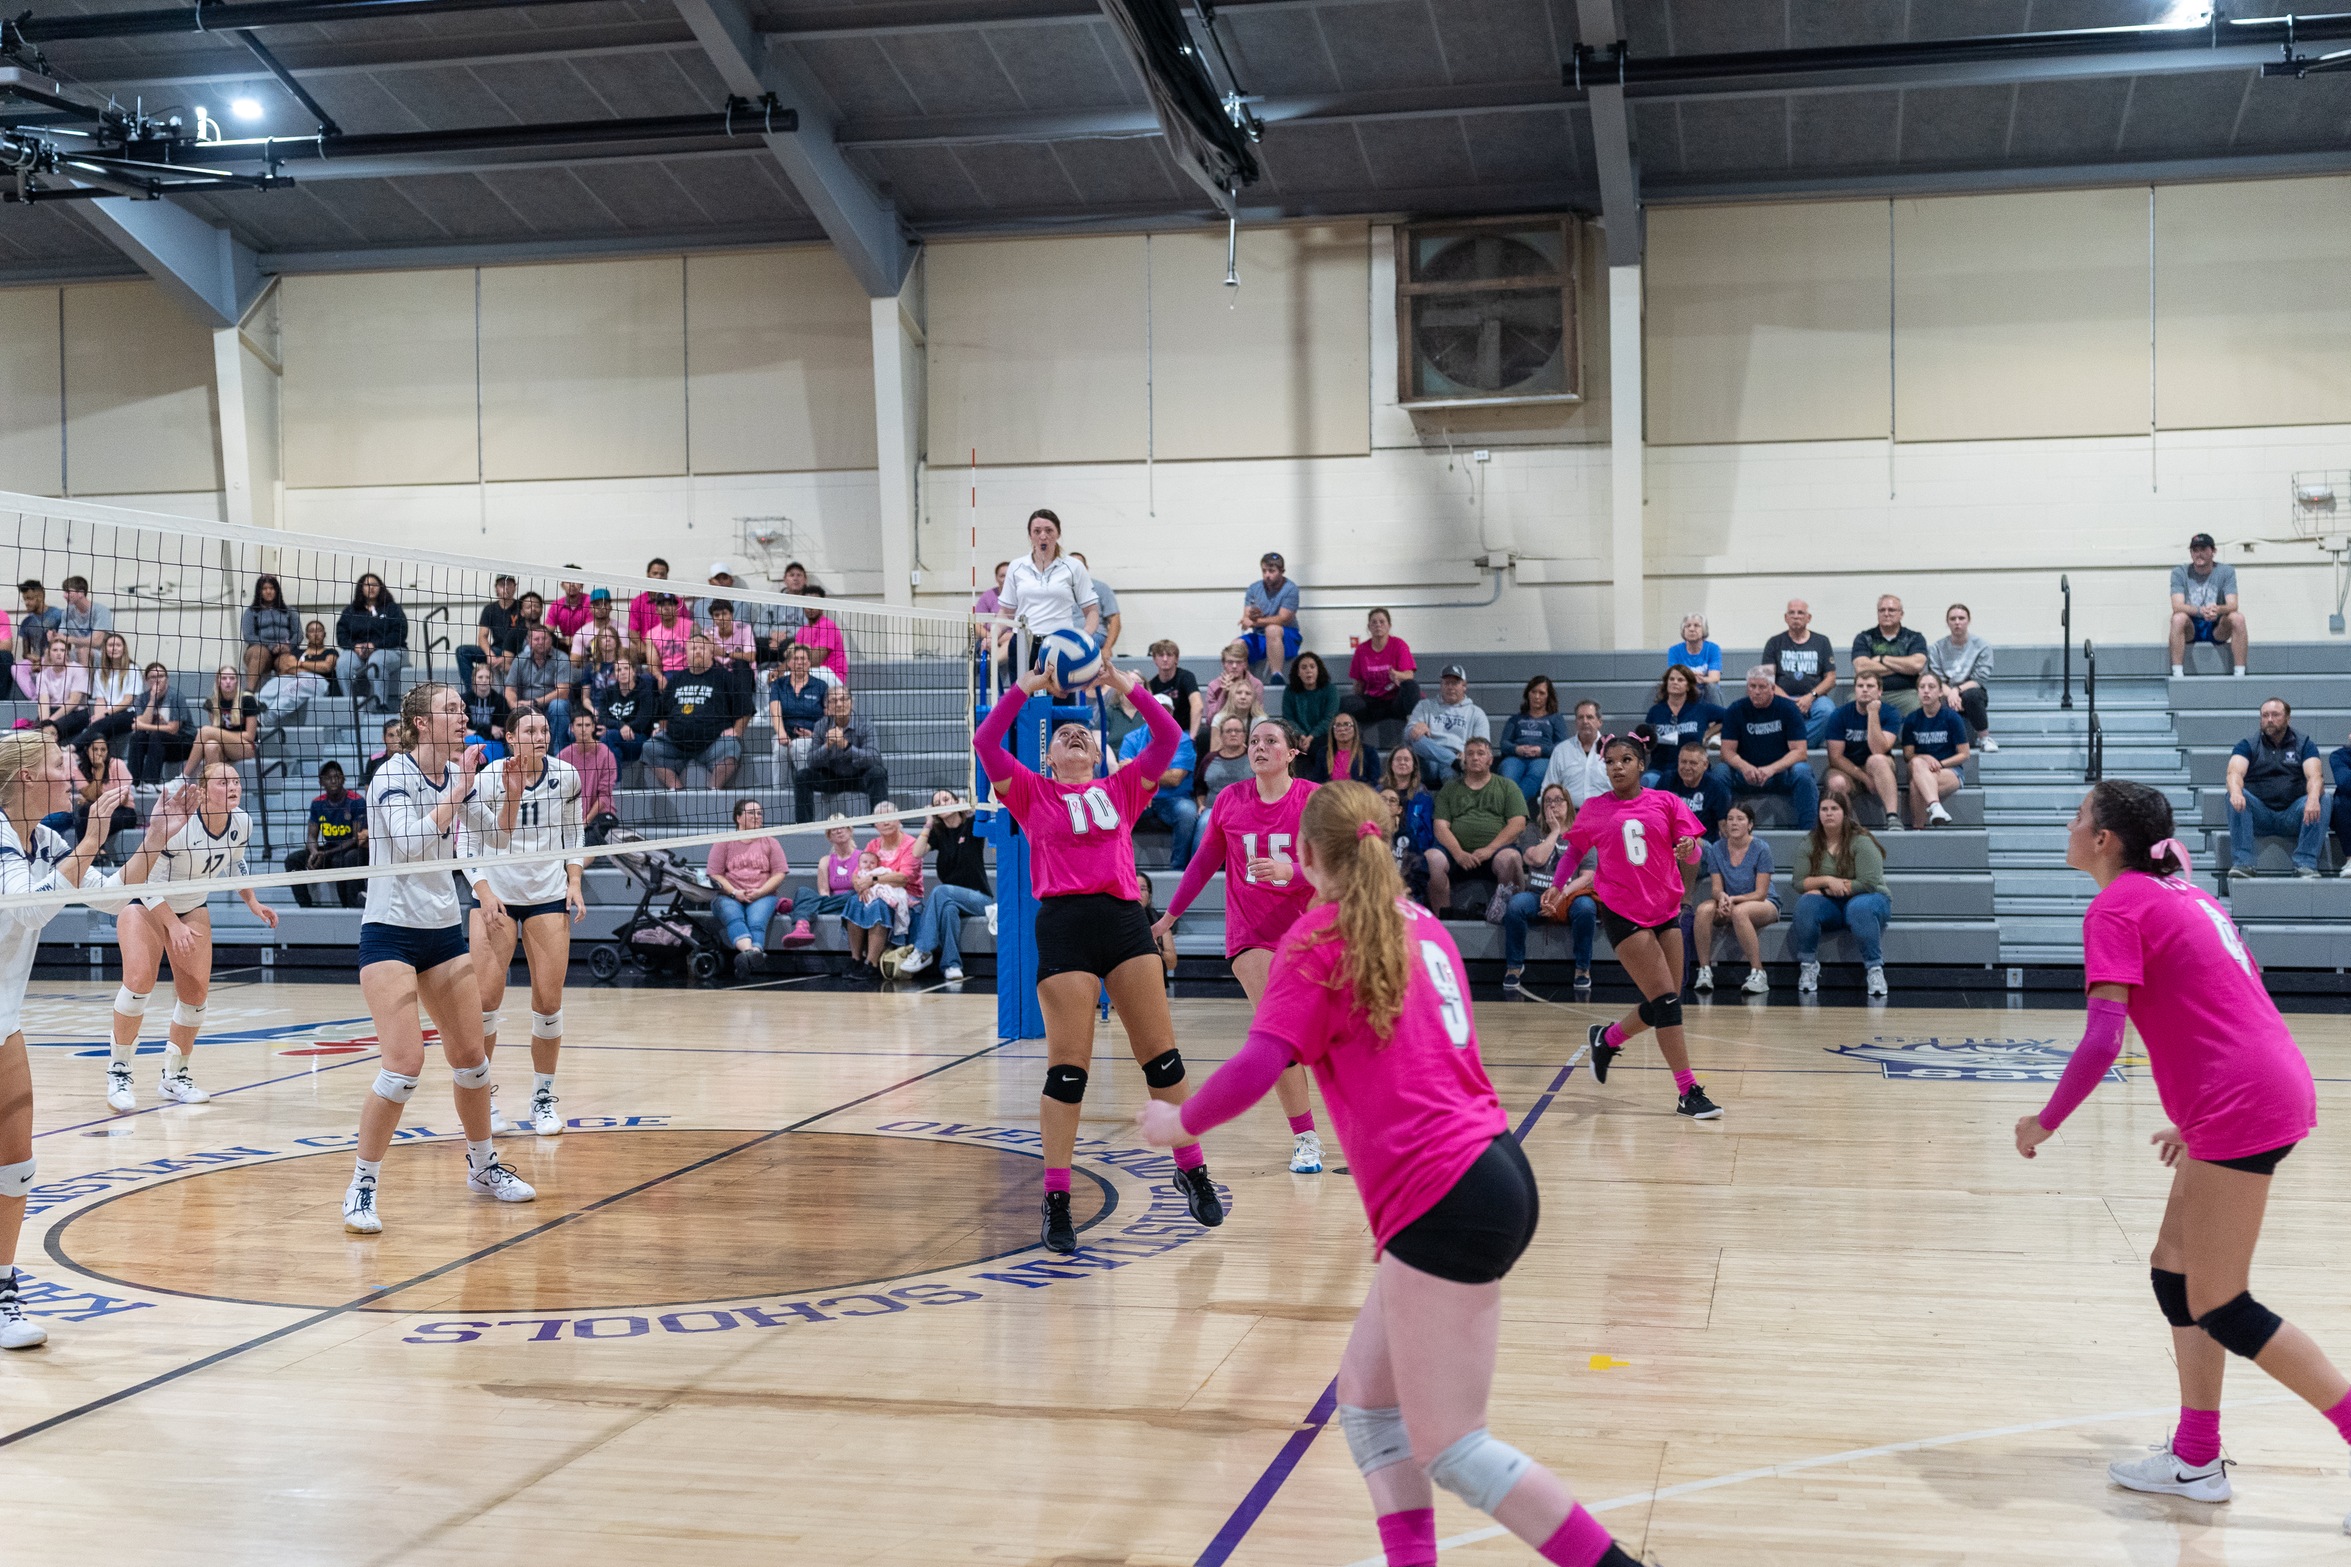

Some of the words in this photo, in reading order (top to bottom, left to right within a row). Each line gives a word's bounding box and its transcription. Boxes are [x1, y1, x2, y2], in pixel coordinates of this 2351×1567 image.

[1781, 650, 1818, 660] TOGETHER
[1781, 660, 1796, 672] WE
[1797, 660, 1818, 672] WIN
[521, 801, 539, 826] 11
[1062, 786, 1120, 835] 10
[202, 853, 225, 875] 17
[1241, 833, 1292, 887] 15
[1622, 818, 1648, 866] 6
[1420, 939, 1470, 1048] 9
[402, 1283, 984, 1344] SCHOOLS
